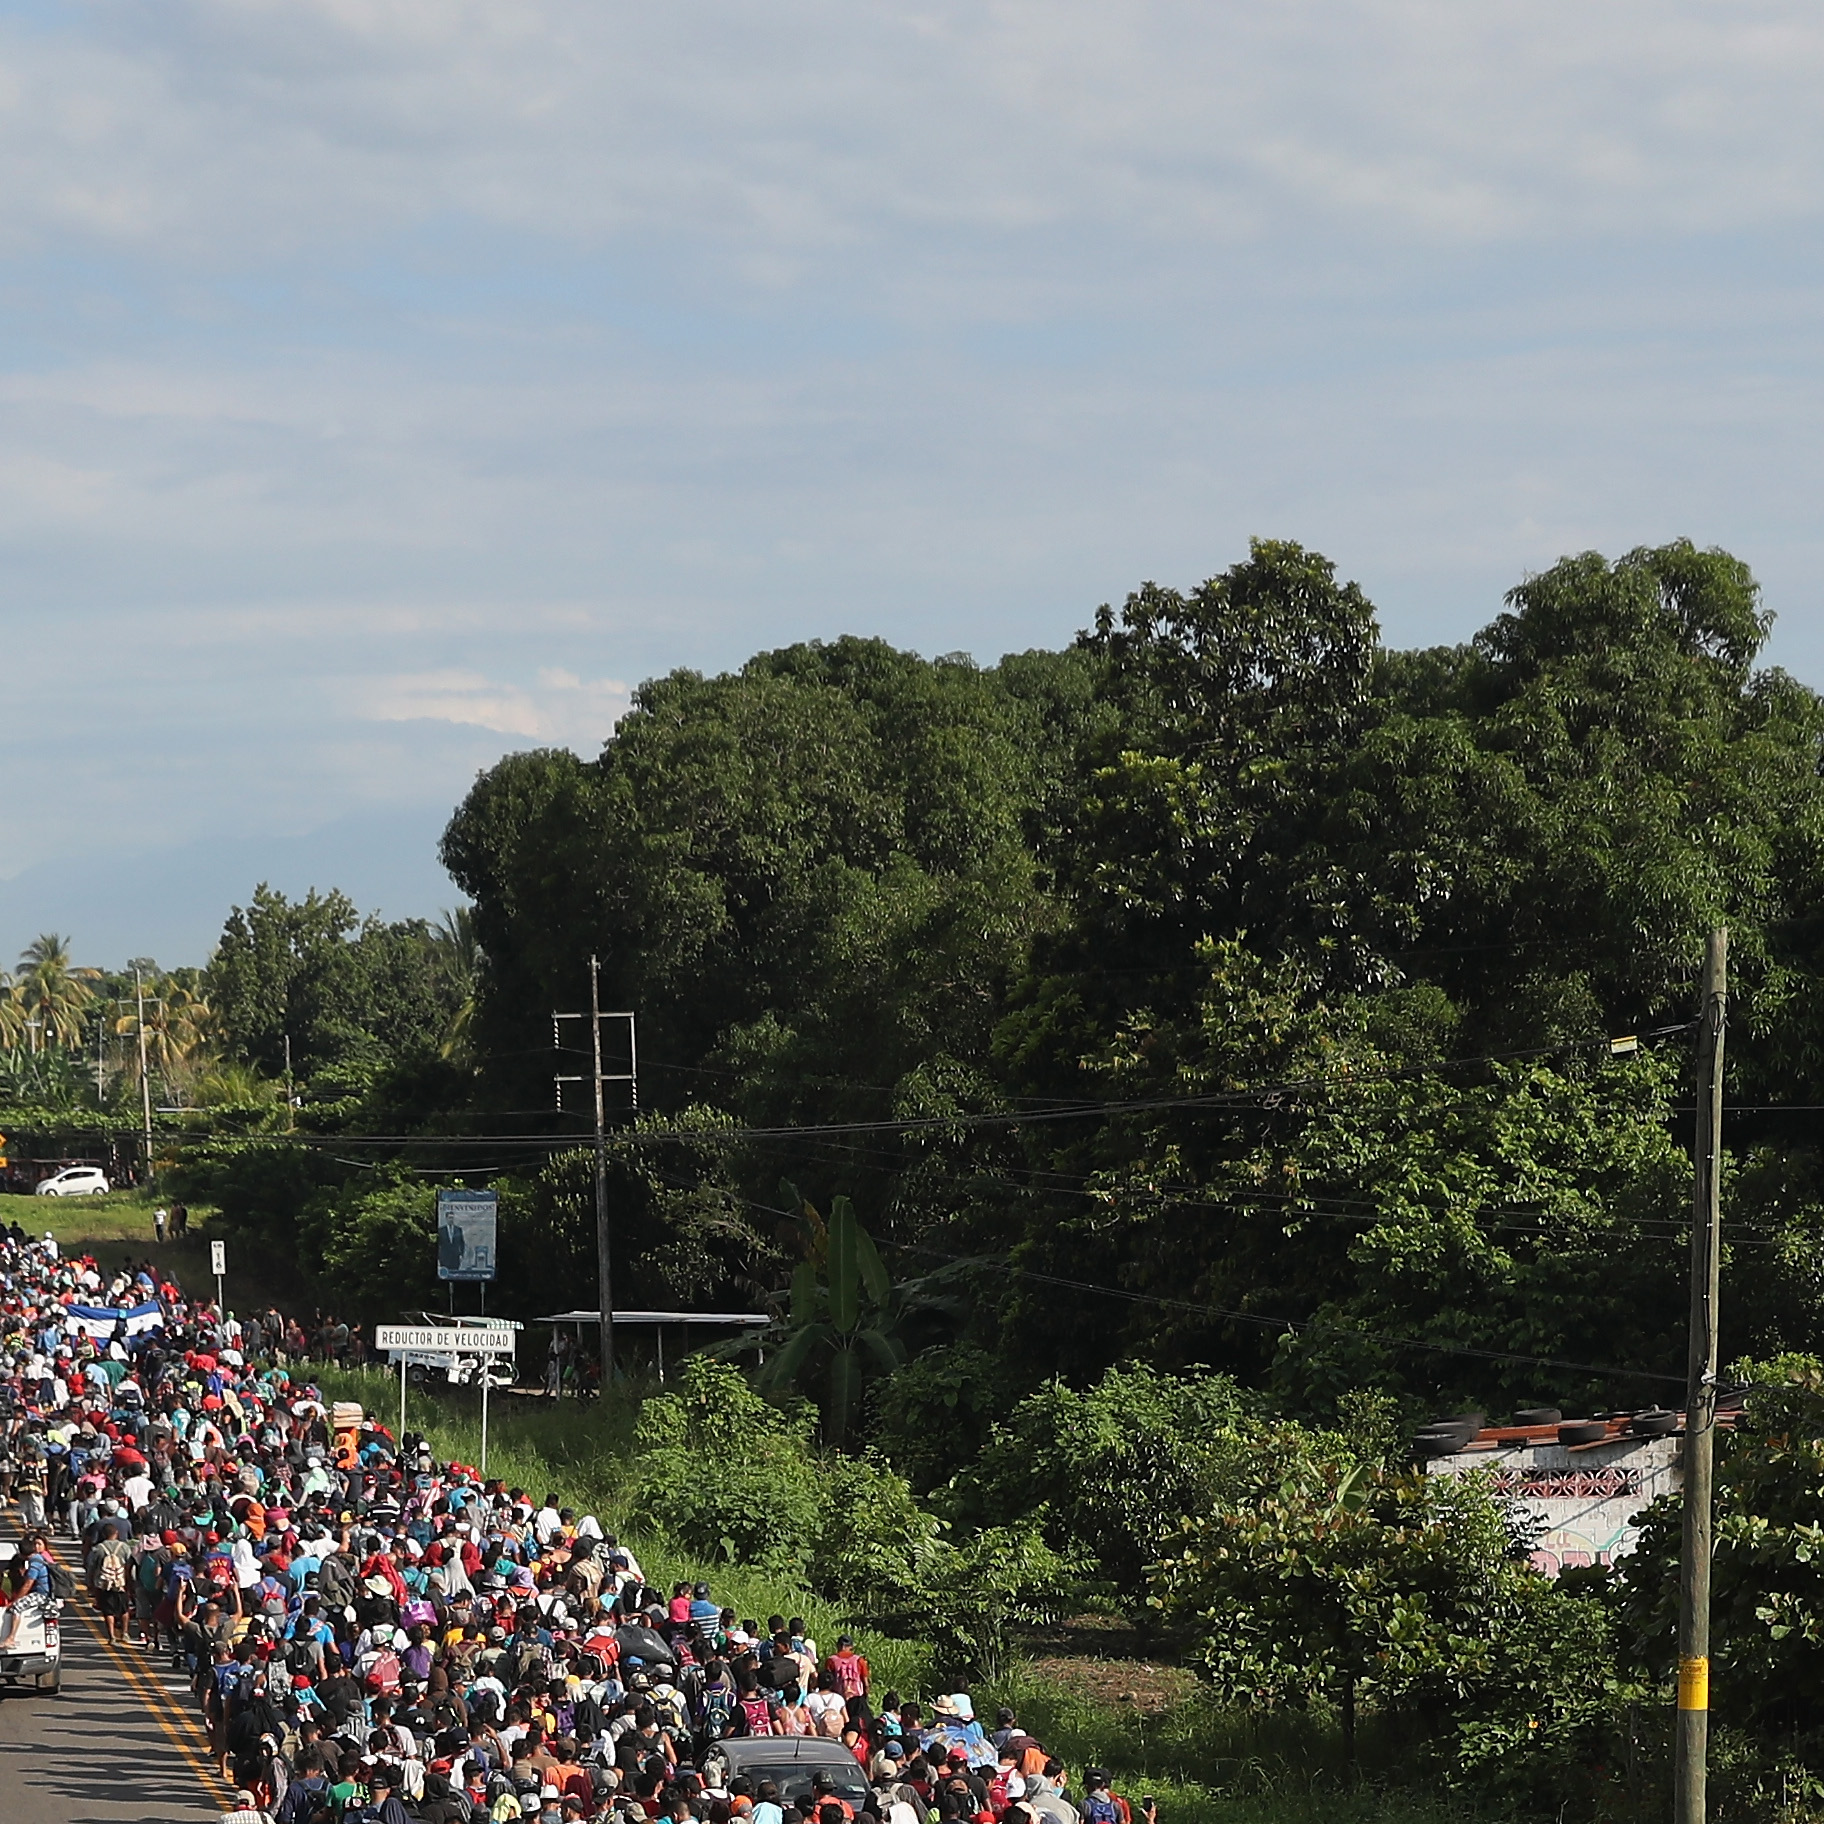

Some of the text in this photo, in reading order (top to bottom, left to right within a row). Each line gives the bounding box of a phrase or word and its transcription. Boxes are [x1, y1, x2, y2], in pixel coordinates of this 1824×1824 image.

[382, 1332, 509, 1347] REDUCTOR DE VELOCIDAD
